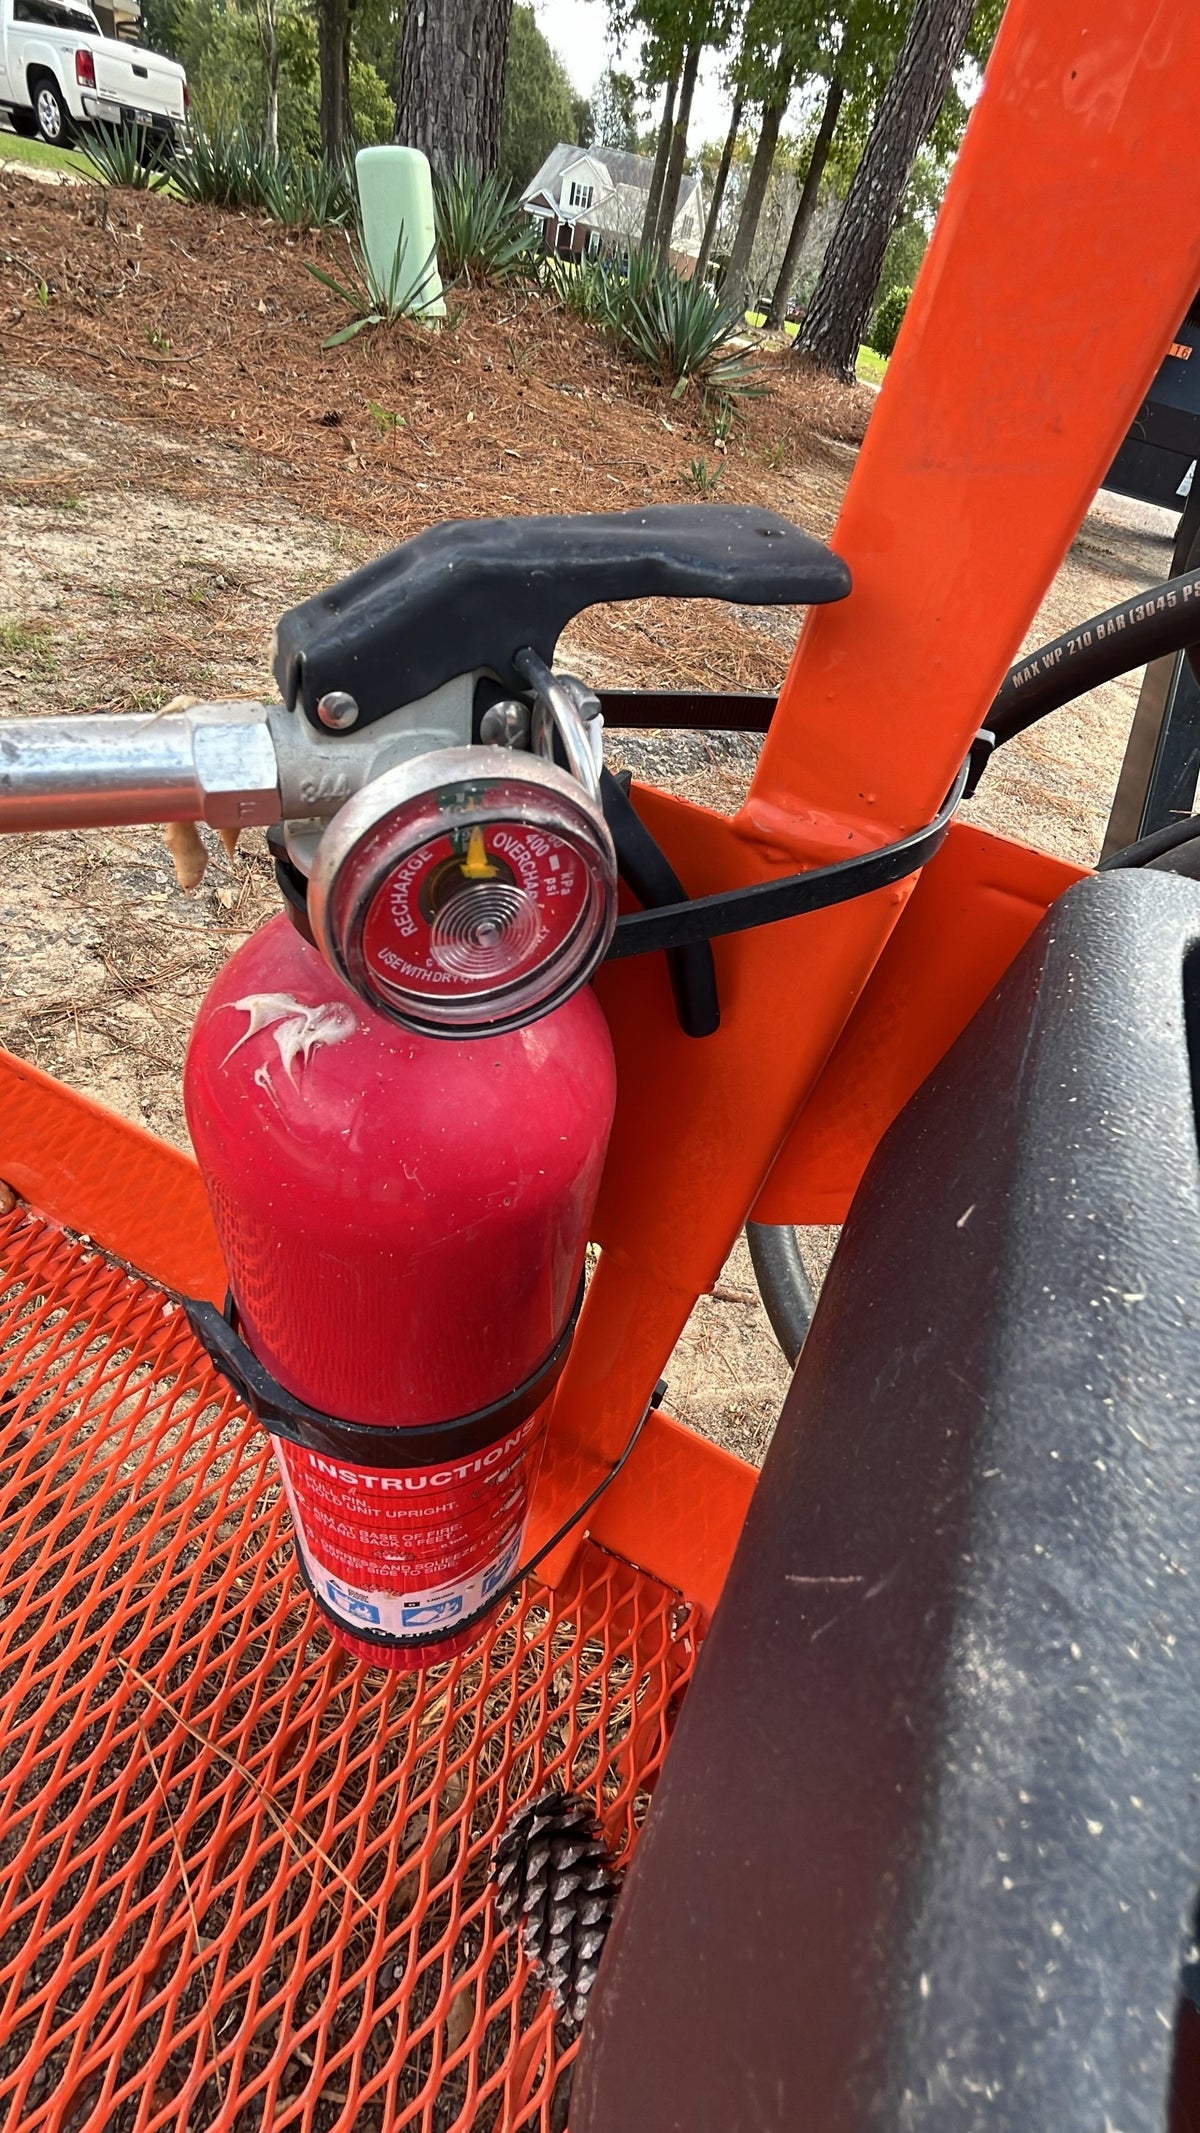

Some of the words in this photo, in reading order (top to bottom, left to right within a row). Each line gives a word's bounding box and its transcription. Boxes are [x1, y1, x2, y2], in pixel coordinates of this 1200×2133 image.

[1012, 661, 1040, 689] MAX
[1042, 647, 1063, 668] WP
[1067, 632, 1092, 656] 210
[1096, 614, 1126, 640] BAR
[1129, 591, 1177, 625] (3045
[525, 834, 550, 857] 400
[493, 832, 542, 906] OVERCHAR
[543, 876, 560, 896] psi
[560, 871, 574, 896] kPa
[390, 848, 433, 938] RECHARGE
[378, 947, 403, 970] USE
[400, 961, 433, 983] WITH
[432, 970, 458, 984] DRY
[308, 1416, 535, 1491] INSTRUCTIONS
[305, 1473, 339, 1498] PULL
[342, 1494, 370, 1508] PIN.
[306, 1479, 342, 1507] HOLD
[346, 1502, 381, 1517] UNIT
[385, 1501, 459, 1518] UPRIGHT.
[313, 1507, 335, 1525] AIM
[338, 1522, 355, 1533] AT
[359, 1529, 397, 1541] BASE
[402, 1533, 423, 1542] OF
[427, 1523, 462, 1539] FIRE.
[359, 1536, 400, 1548] BACK
[367, 1565, 398, 1577] SIDE
[403, 1569, 420, 1577] TO
[381, 1564, 411, 1572] AND
